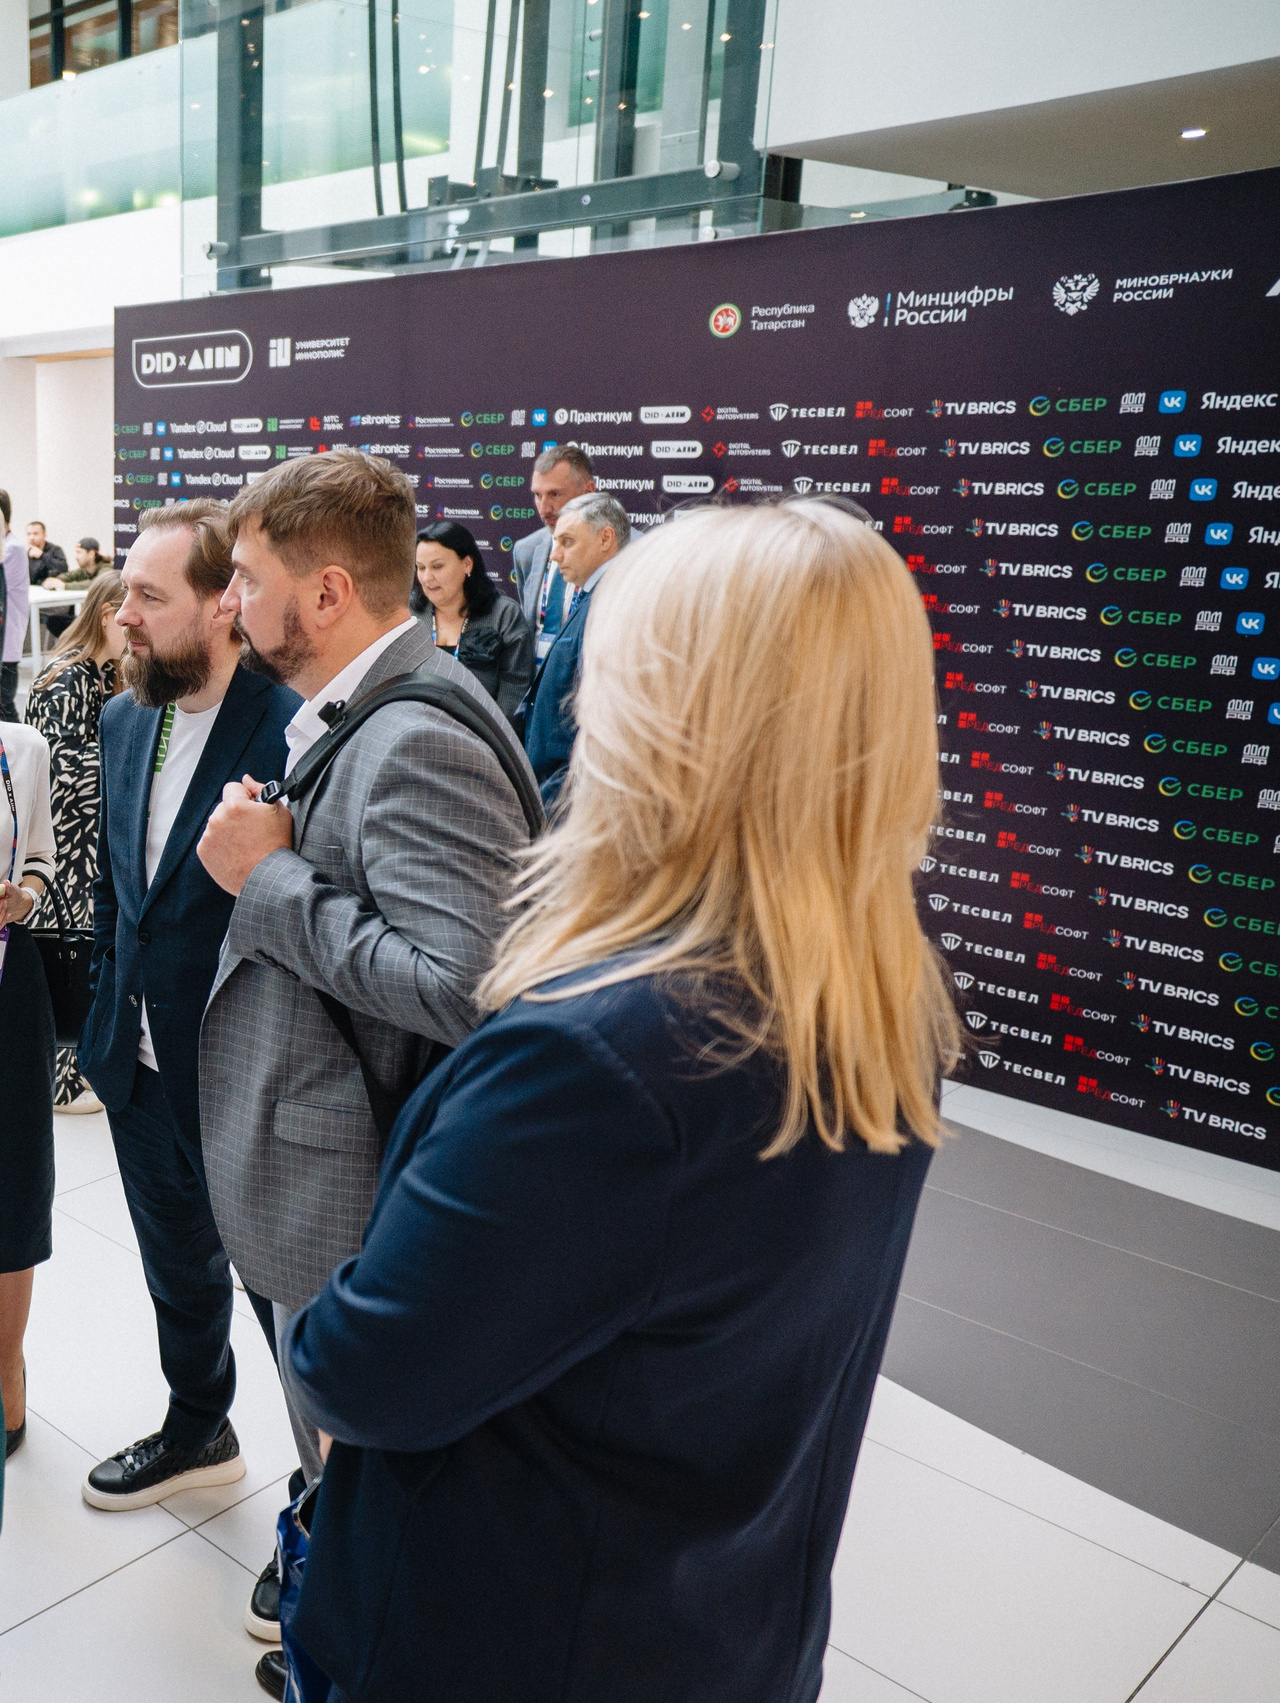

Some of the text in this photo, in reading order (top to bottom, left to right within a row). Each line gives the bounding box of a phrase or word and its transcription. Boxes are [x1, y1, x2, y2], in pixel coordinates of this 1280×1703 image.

[1115, 268, 1233, 289] МИНОБРНАУКИ
[897, 285, 1014, 307] Минцифры
[1112, 288, 1174, 303] РОССИИ
[751, 303, 815, 318] Республика
[894, 308, 967, 327] России
[750, 318, 805, 332] Татарстан
[295, 337, 350, 350] УНИВЕРСИТЕТ
[295, 349, 345, 361] ИННОПОЛИС
[141, 353, 177, 375] DID
[967, 401, 1016, 414] BRICS
[1056, 398, 1107, 411] СБЕР
[1201, 392, 1278, 411] Яндекс
[361, 414, 402, 425] sitronics
[476, 413, 505, 424] СБЕР
[570, 410, 632, 424] Практикум
[791, 407, 845, 418] ТЕСВЕЛ
[370, 444, 411, 455] sitronics
[486, 444, 515, 456] СБЕР
[581, 443, 643, 458] Практикум
[803, 445, 858, 455] ТЕСВЕЛ
[981, 442, 1030, 454] BRICS
[1070, 440, 1122, 453] СБЕР
[496, 476, 525, 487] СБЕР
[816, 482, 870, 492] ТЕСВЕЛ
[994, 483, 1044, 495] BRICS
[1084, 483, 1136, 496] СБЕР
[505, 507, 535, 519] СБЕР
[1008, 523, 1058, 537] BRICS
[1099, 525, 1152, 538] СБЕР
[1022, 564, 1072, 578] BRICS
[1113, 568, 1167, 581] СБЕР
[1036, 606, 1086, 620] BRICS
[1128, 610, 1182, 625] СБЕР
[1050, 646, 1101, 662] BRICS
[1143, 653, 1197, 668] СБЕР
[1064, 688, 1115, 704] BRICS
[1157, 696, 1212, 712] СБЕР
[1077, 729, 1129, 746] BRICS
[1172, 740, 1227, 756] СБЕР
[1092, 771, 1144, 789] BRICS
[1188, 784, 1243, 800] СБЕР
[1106, 813, 1159, 832] BRICS
[1203, 828, 1259, 845] СБЕР
[1120, 856, 1173, 875] BRICS
[940, 864, 999, 883] ТЕСВЕЛ
[1218, 872, 1275, 889] СБЕР
[953, 903, 1012, 923] ТЕСВЕЛ
[1135, 898, 1188, 918] BRICS
[965, 942, 1025, 963] ТЕСВЕЛ
[1149, 941, 1203, 962] BRICS
[978, 982, 1038, 1003] ТЕСВЕЛ
[1164, 984, 1219, 1006] BRICS
[991, 1021, 1051, 1044] ТЕСВЕЛ
[1179, 1027, 1234, 1050] BRICS
[1004, 1061, 1065, 1085] ТЕСВЕЛ
[1193, 1071, 1250, 1094] BRICS
[1209, 1115, 1266, 1139] BRICS
